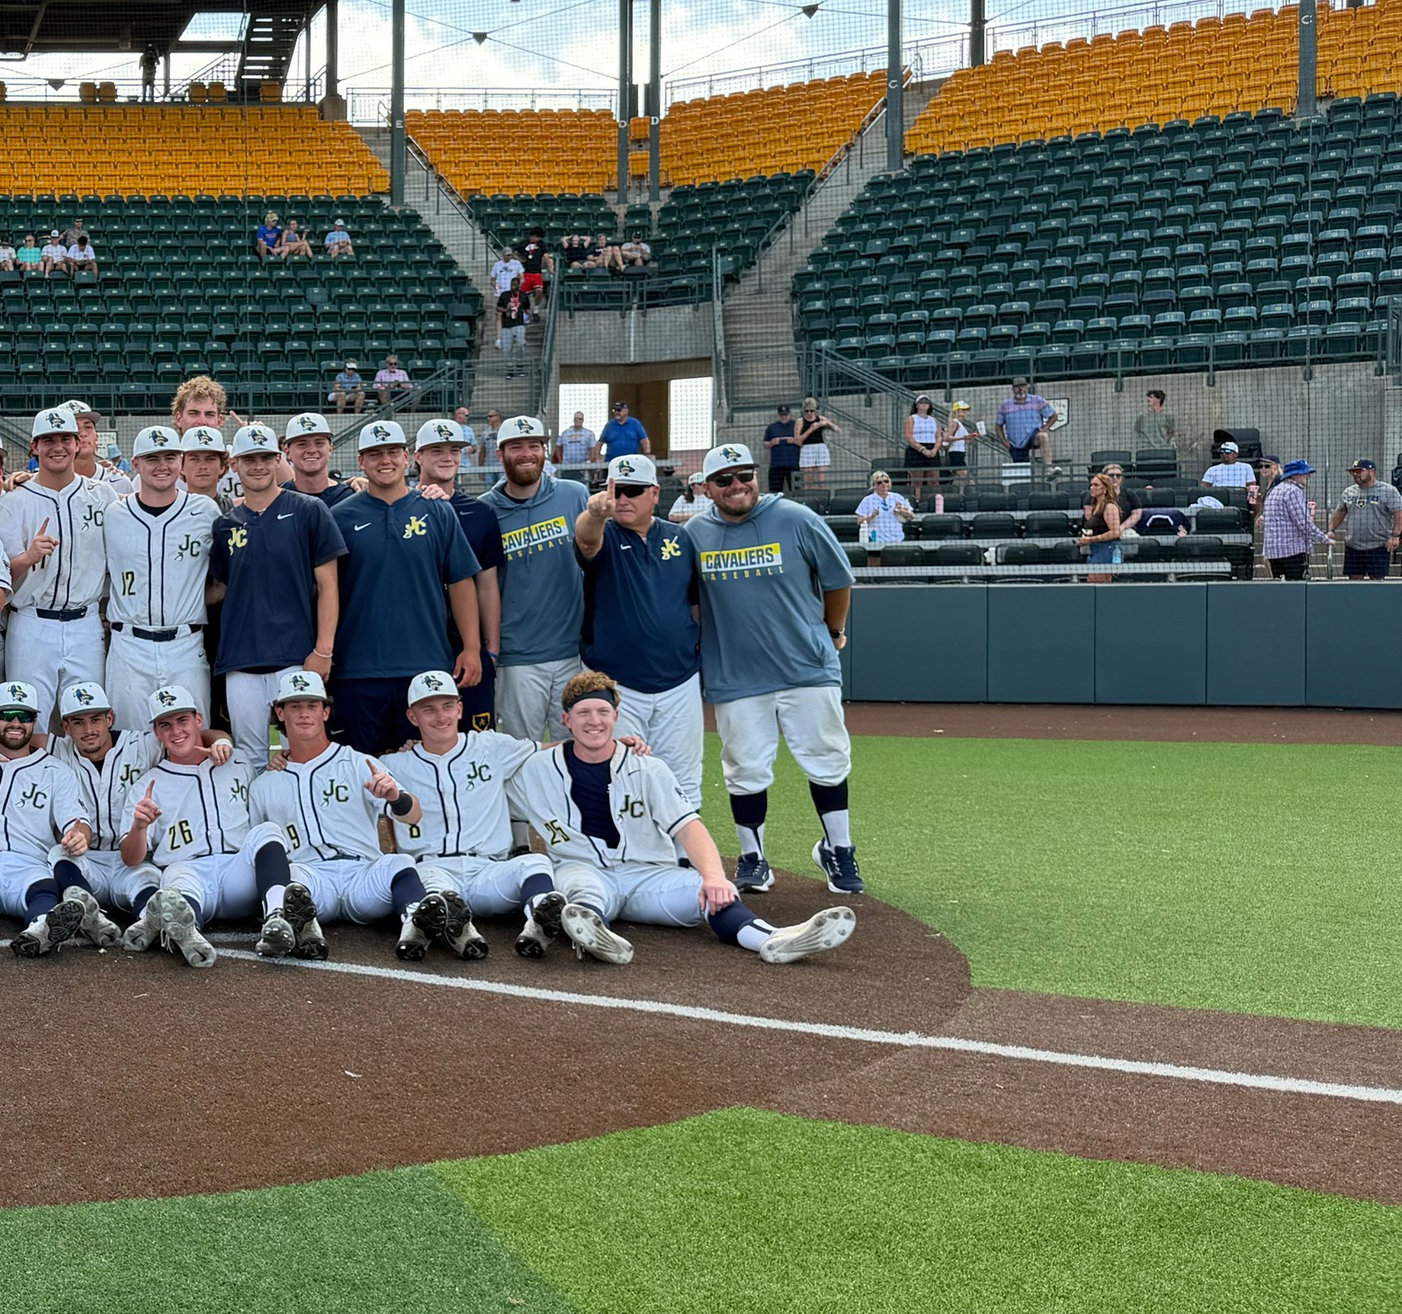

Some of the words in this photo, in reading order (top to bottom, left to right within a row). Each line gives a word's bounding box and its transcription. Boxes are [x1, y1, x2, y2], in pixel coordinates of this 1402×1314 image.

[887, 79, 899, 89] C
[395, 120, 405, 130] E
[651, 116, 660, 126] D
[83, 505, 104, 527] JC
[178, 534, 201, 557] JC
[502, 519, 563, 550] CAVALIERS
[507, 537, 573, 562] ASEBALL
[705, 547, 775, 571] CAVALIERS
[121, 571, 137, 597] 12
[467, 760, 492, 783] JC
[23, 781, 47, 810] JC
[323, 779, 349, 803] JC
[619, 795, 645, 818] JC
[168, 819, 195, 851] 26
[286, 824, 301, 850] 9
[544, 819, 571, 847] 25
